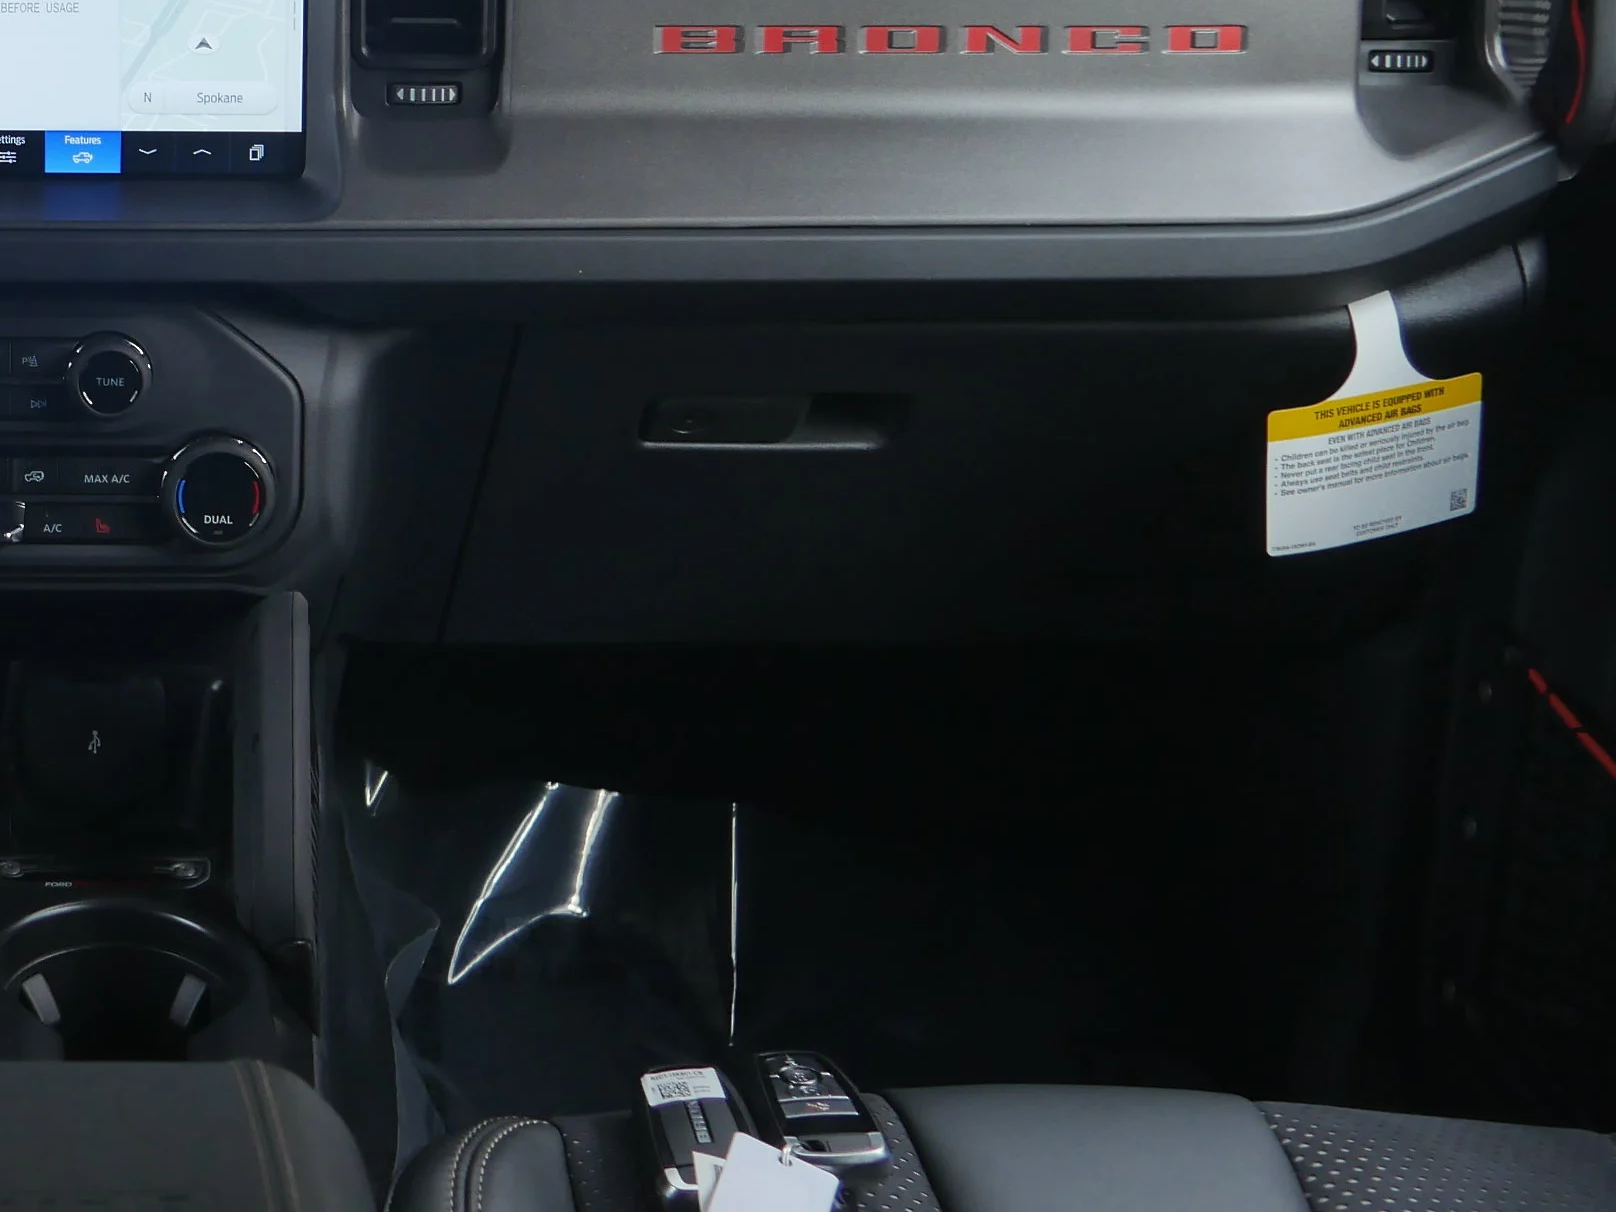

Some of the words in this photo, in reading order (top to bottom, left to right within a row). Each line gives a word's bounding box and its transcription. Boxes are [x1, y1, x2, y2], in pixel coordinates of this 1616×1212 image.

[0, 3, 40, 14] BEFORE
[46, 3, 80, 14] USAGE
[651, 24, 1250, 55] BRONCO
[143, 92, 152, 103] N
[196, 92, 244, 105] Spokane
[64, 135, 101, 145] Features
[95, 377, 125, 387] TUNE
[1314, 408, 1333, 419] THIS
[1336, 402, 1370, 415] VEHICLE
[1372, 400, 1380, 408] IS
[1383, 392, 1421, 406] EQUIPPED
[1424, 387, 1444, 398] WITH
[1339, 412, 1381, 427] ADVANCED
[1384, 409, 1397, 418] AIR
[1400, 404, 1422, 415] BAGS
[1328, 435, 1345, 444] EVEN
[1347, 431, 1364, 440] WITH
[1366, 424, 1399, 436] ADVANCED
[1402, 421, 1412, 429] AIR
[1414, 417, 1431, 426] BAGS
[84, 474, 108, 483] MAX
[111, 474, 131, 484] A/C
[203, 515, 233, 524] DUAL
[43, 523, 63, 533] A/C
